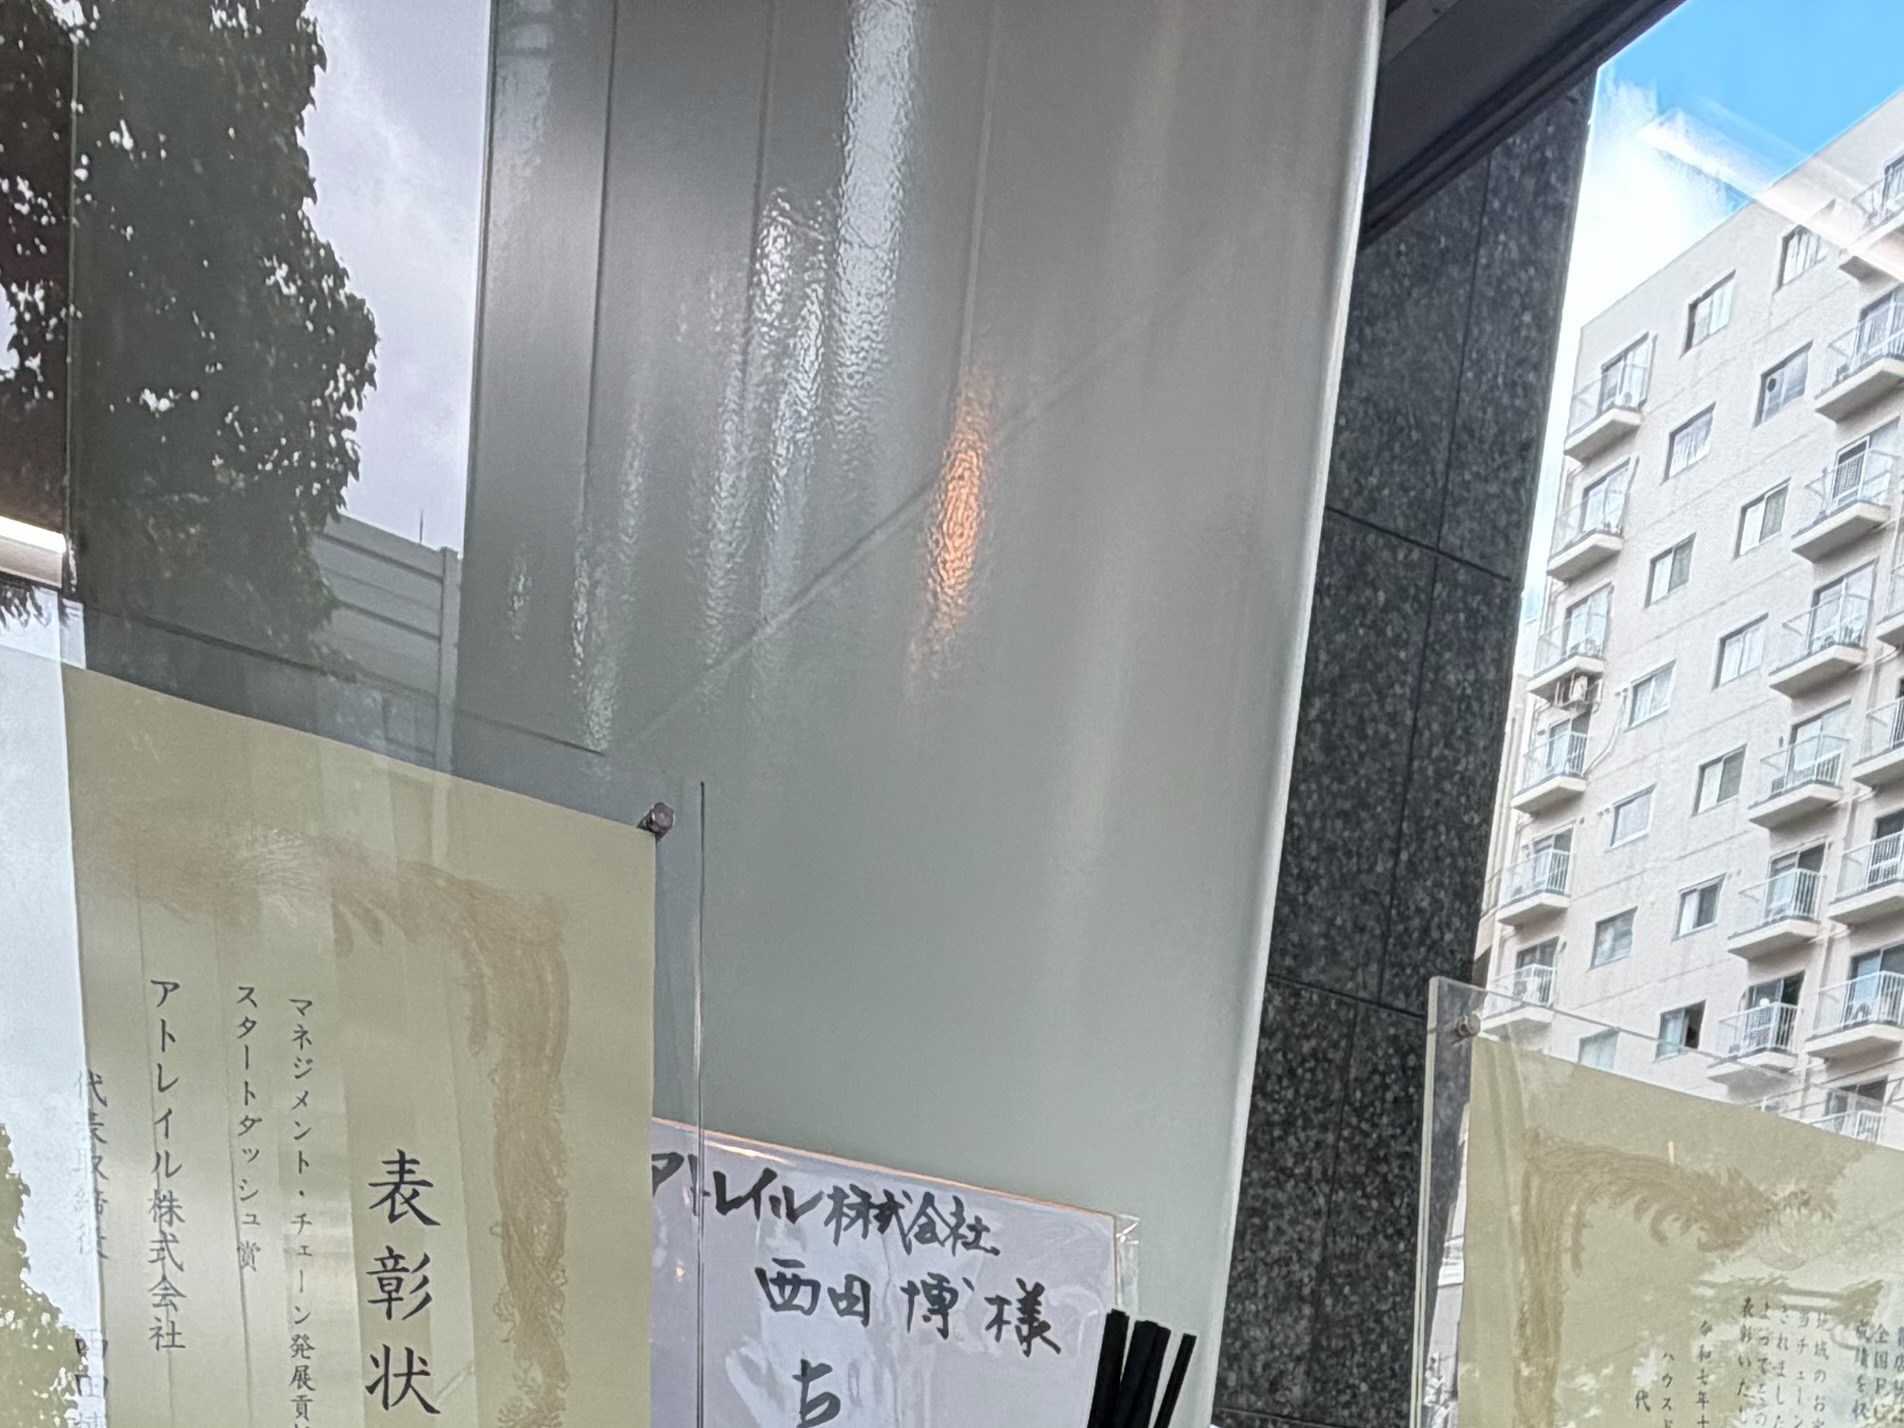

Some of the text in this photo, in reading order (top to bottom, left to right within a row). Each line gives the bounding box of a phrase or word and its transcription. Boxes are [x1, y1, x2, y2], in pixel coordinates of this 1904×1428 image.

[147, 978, 187, 1352] アトレイル株式会社
[235, 984, 264, 1273] スタートダッシュ賞
[364, 1147, 442, 1416] 表彰状
